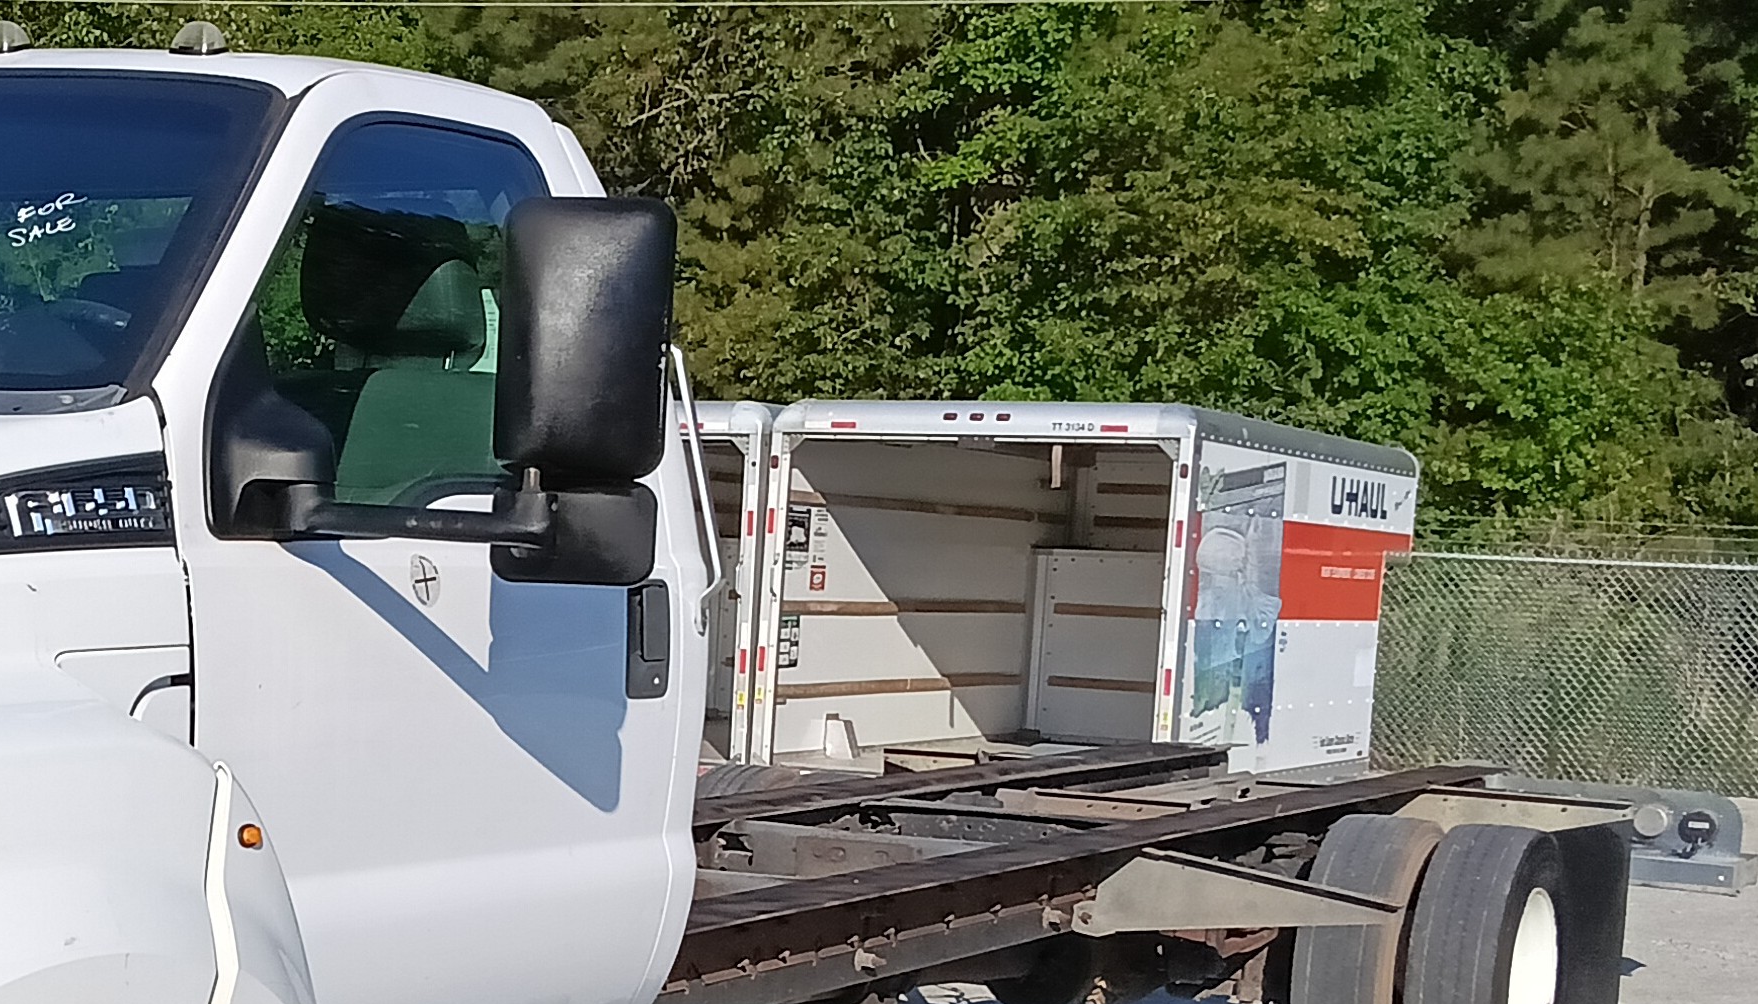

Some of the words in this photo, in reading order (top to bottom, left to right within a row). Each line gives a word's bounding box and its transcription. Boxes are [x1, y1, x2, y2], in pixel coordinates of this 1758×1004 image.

[17, 192, 88, 223] FOR
[7, 215, 76, 247] SALE
[1052, 422, 1063, 431] TT
[1330, 475, 1387, 520] U-HAUL
